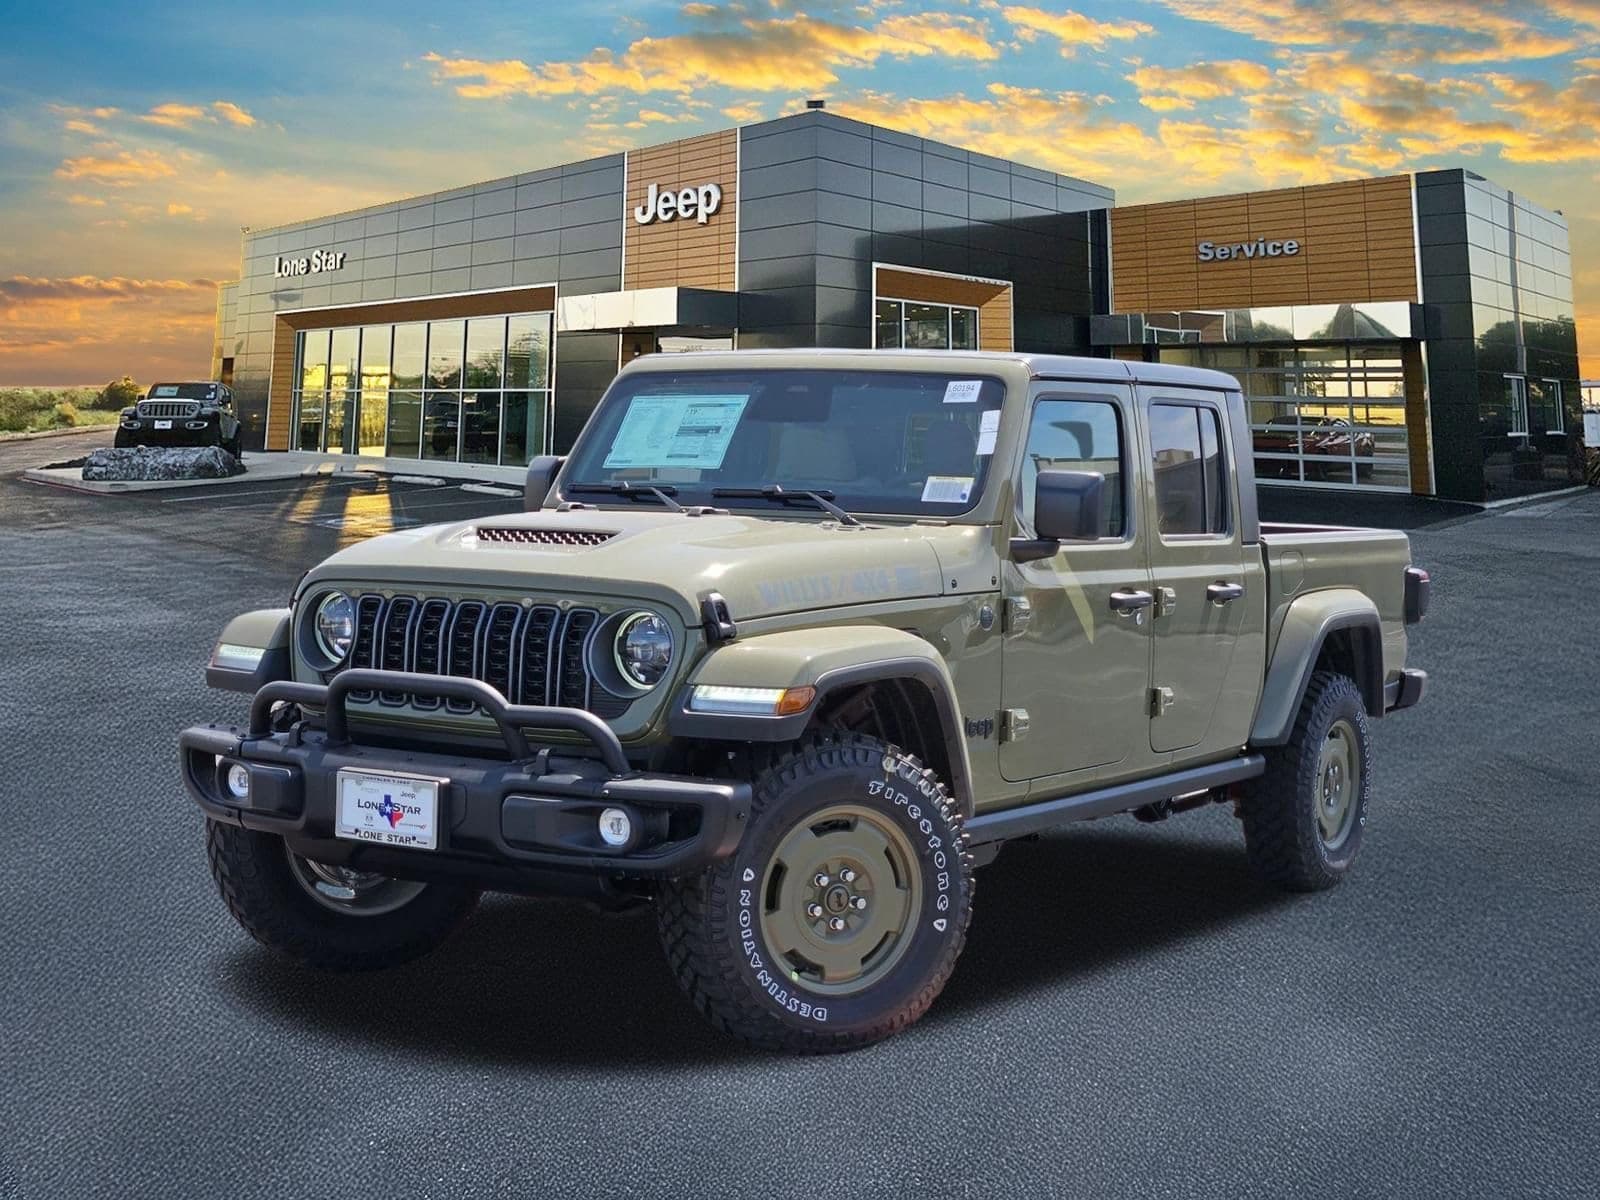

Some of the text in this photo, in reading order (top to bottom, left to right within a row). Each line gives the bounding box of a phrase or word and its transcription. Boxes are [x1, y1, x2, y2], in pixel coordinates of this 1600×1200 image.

[634, 183, 721, 224] Jeep
[1198, 236, 1299, 260] Service
[275, 249, 345, 278] Lone Star
[357, 798, 421, 815] LONE STAR
[358, 830, 383, 841] LONE
[386, 835, 412, 845] STAR
[739, 889, 828, 1021] DESTINATION
